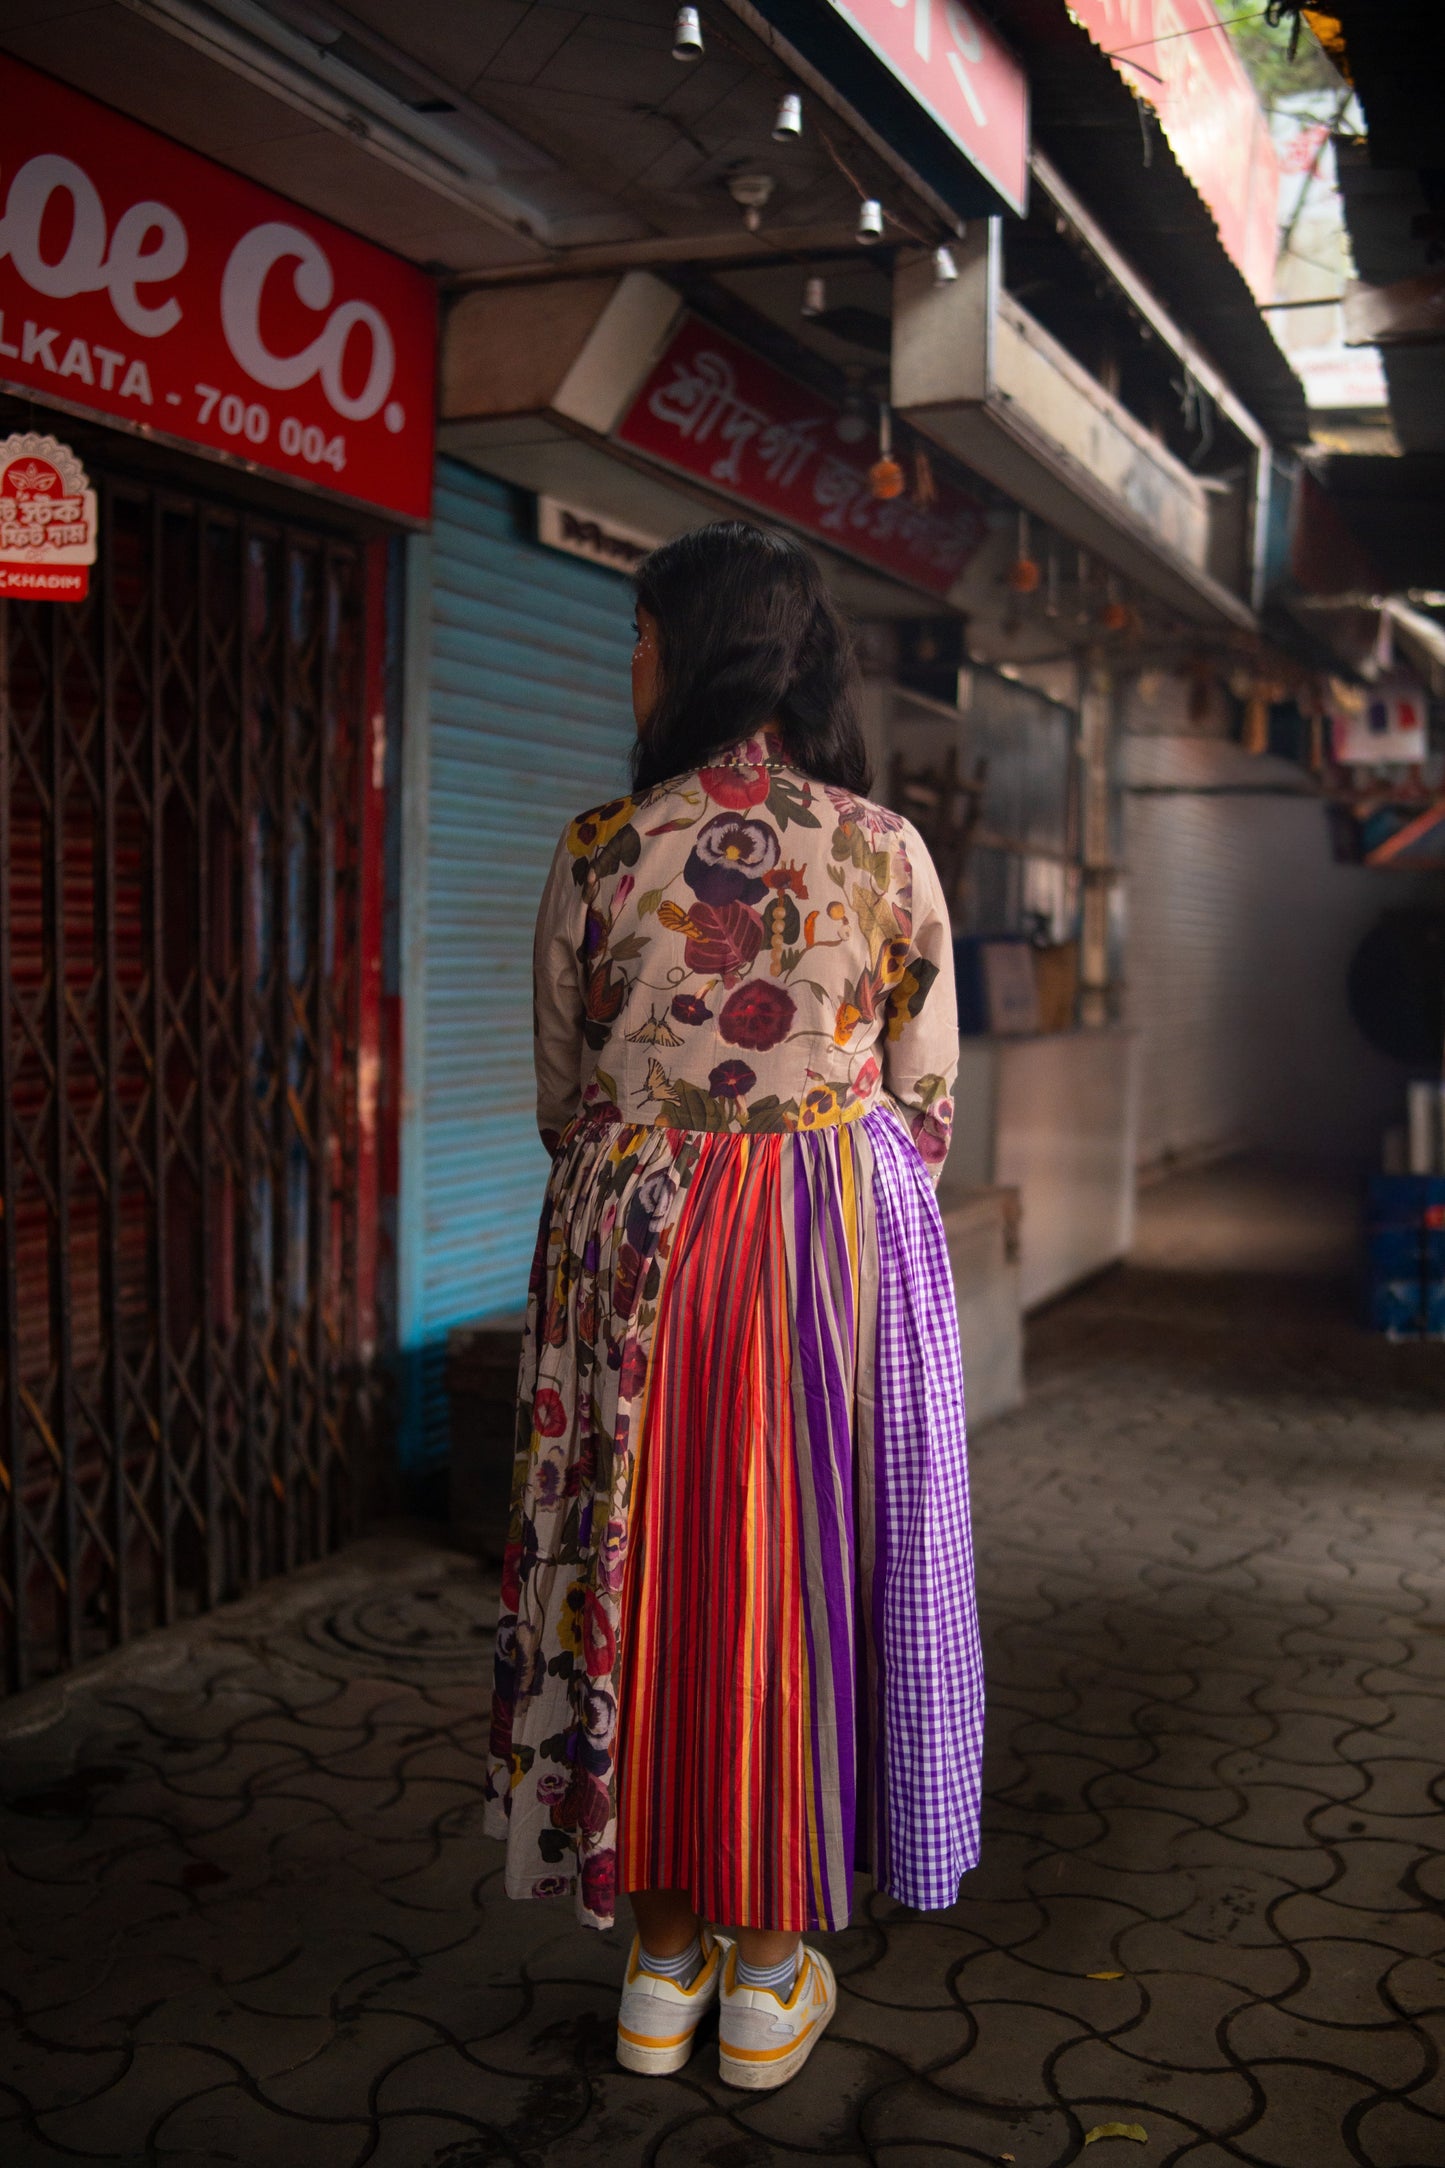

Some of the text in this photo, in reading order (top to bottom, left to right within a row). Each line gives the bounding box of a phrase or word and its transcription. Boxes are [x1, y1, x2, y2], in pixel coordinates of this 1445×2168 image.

[0, 153, 406, 434] oe Co.
[195, 383, 270, 444] 700
[279, 416, 347, 472] 004
[8, 573, 81, 589] KHADIM
